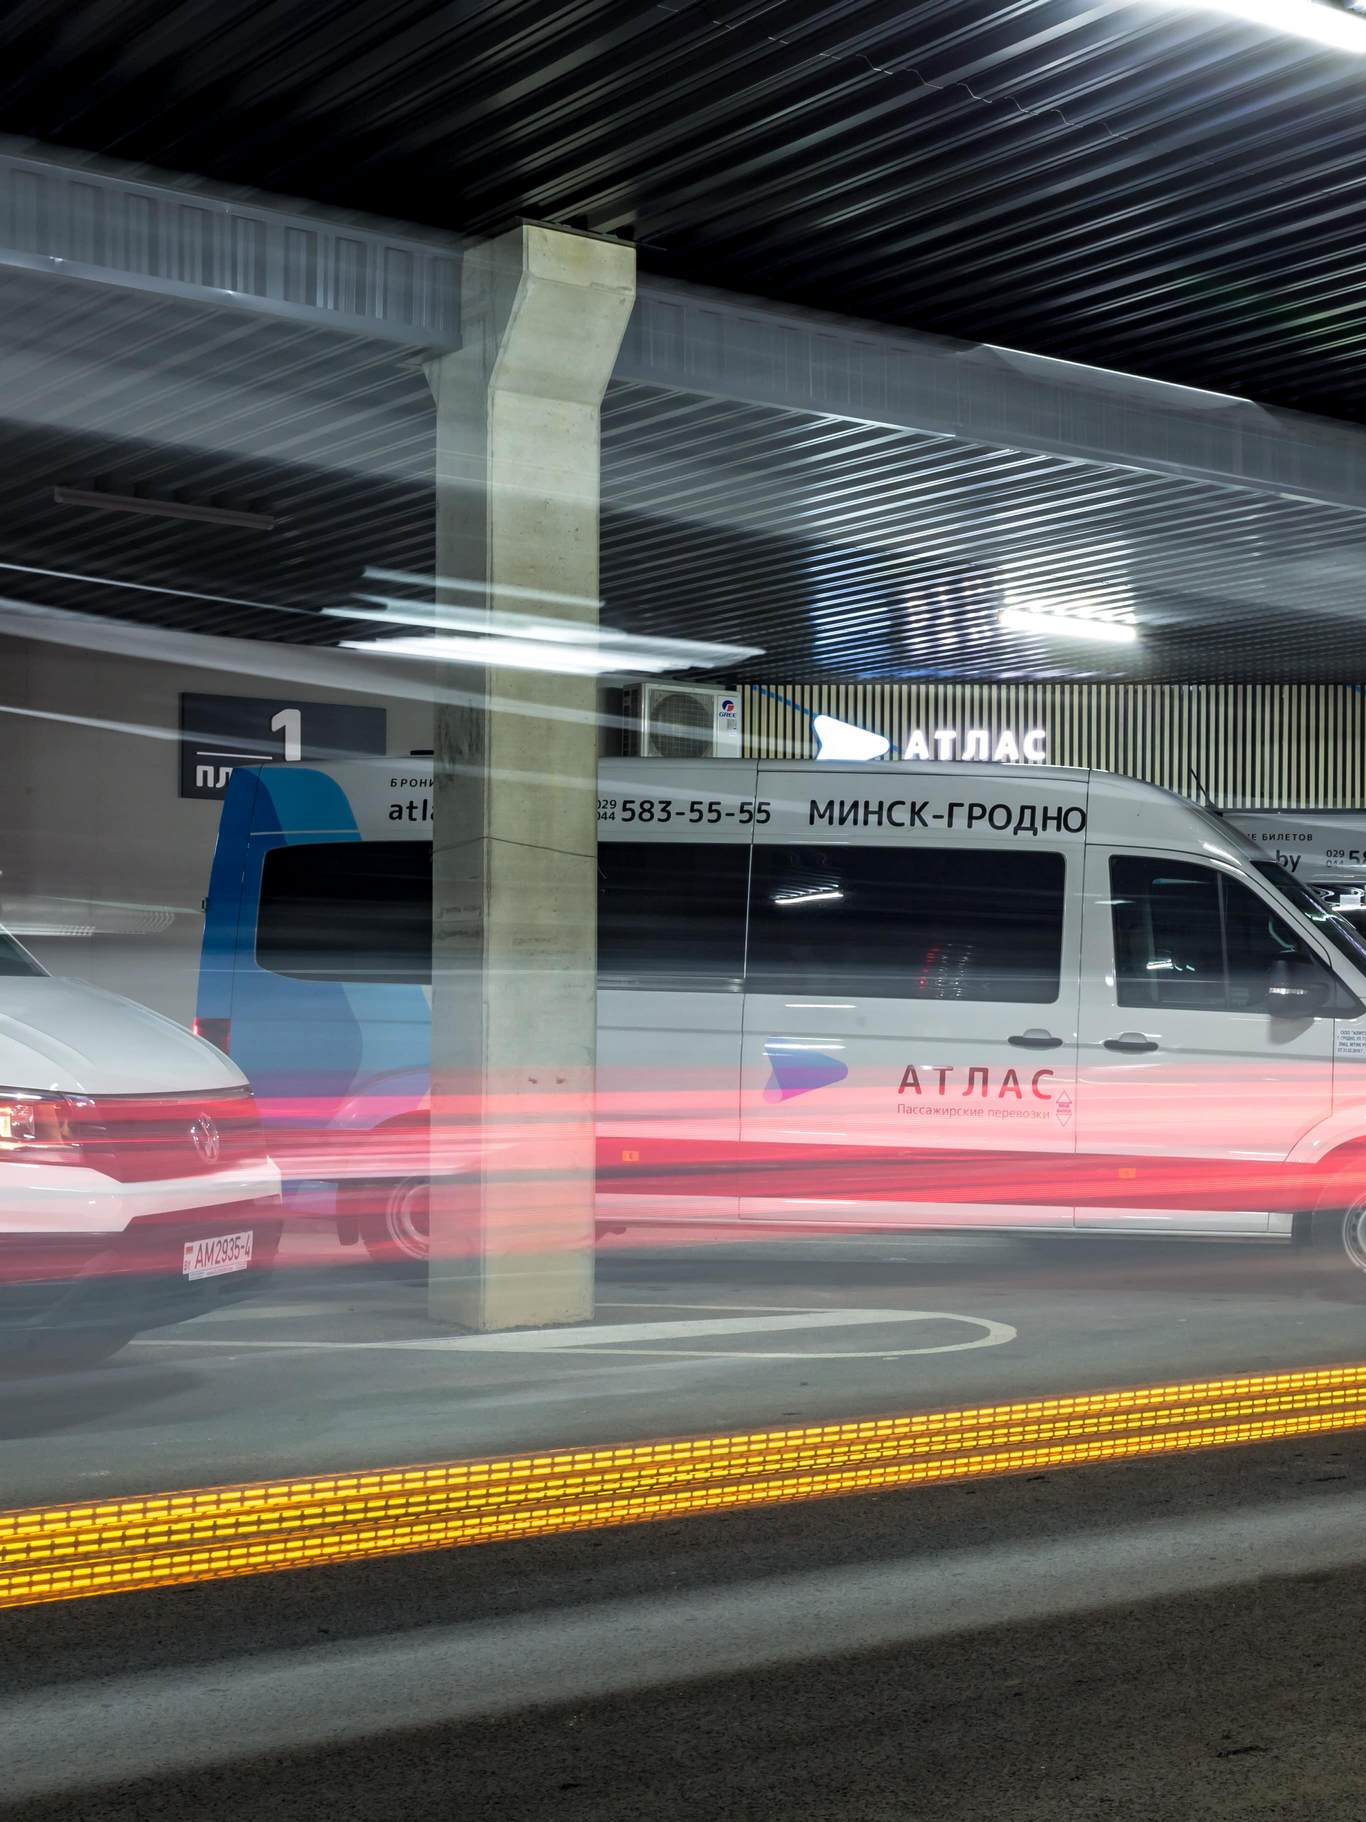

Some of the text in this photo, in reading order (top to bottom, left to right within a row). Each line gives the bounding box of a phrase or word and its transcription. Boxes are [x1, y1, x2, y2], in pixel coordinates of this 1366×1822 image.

[270, 708, 302, 762] 1
[903, 728, 1047, 761] АТЛАС
[388, 798, 434, 822] atl
[621, 799, 772, 825] 583-55-55
[808, 799, 1087, 837] МИНСК-ГРОДНО
[1261, 832, 1314, 842] БИЛЕТОВ
[1325, 849, 1345, 858] 029
[897, 1063, 1054, 1100] АТЛАС
[897, 1103, 985, 1119] Пассажирские
[987, 1108, 1051, 1121] перевозки
